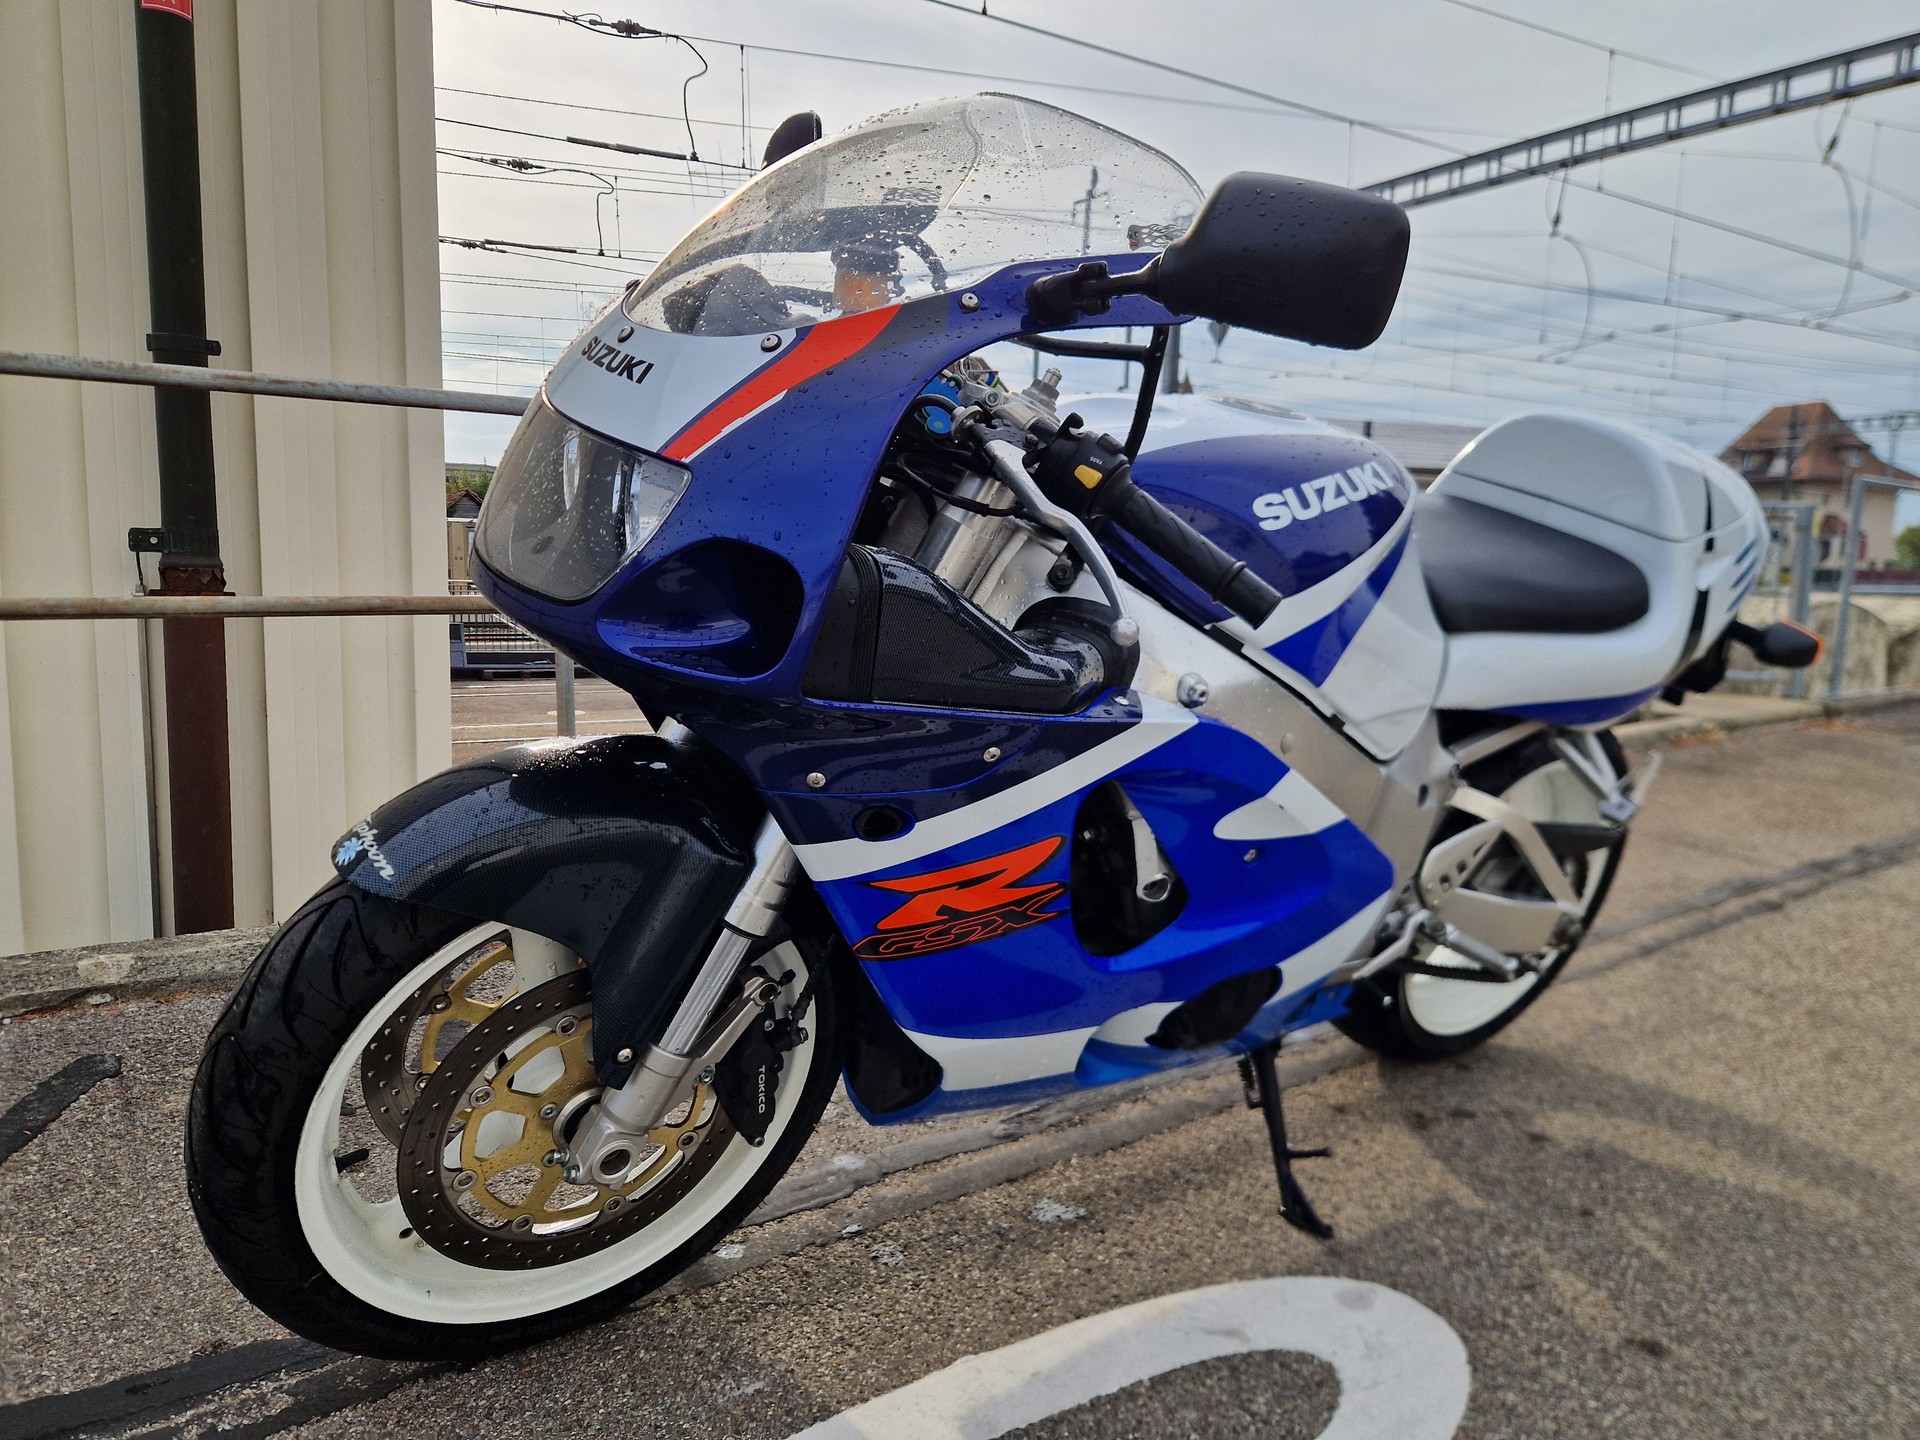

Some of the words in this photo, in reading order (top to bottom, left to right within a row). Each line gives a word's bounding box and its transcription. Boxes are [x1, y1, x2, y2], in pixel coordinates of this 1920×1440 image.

[581, 336, 655, 384] SUZUKI
[1252, 462, 1395, 531] SUZUKI
[758, 1065, 766, 1114] TOKICO
